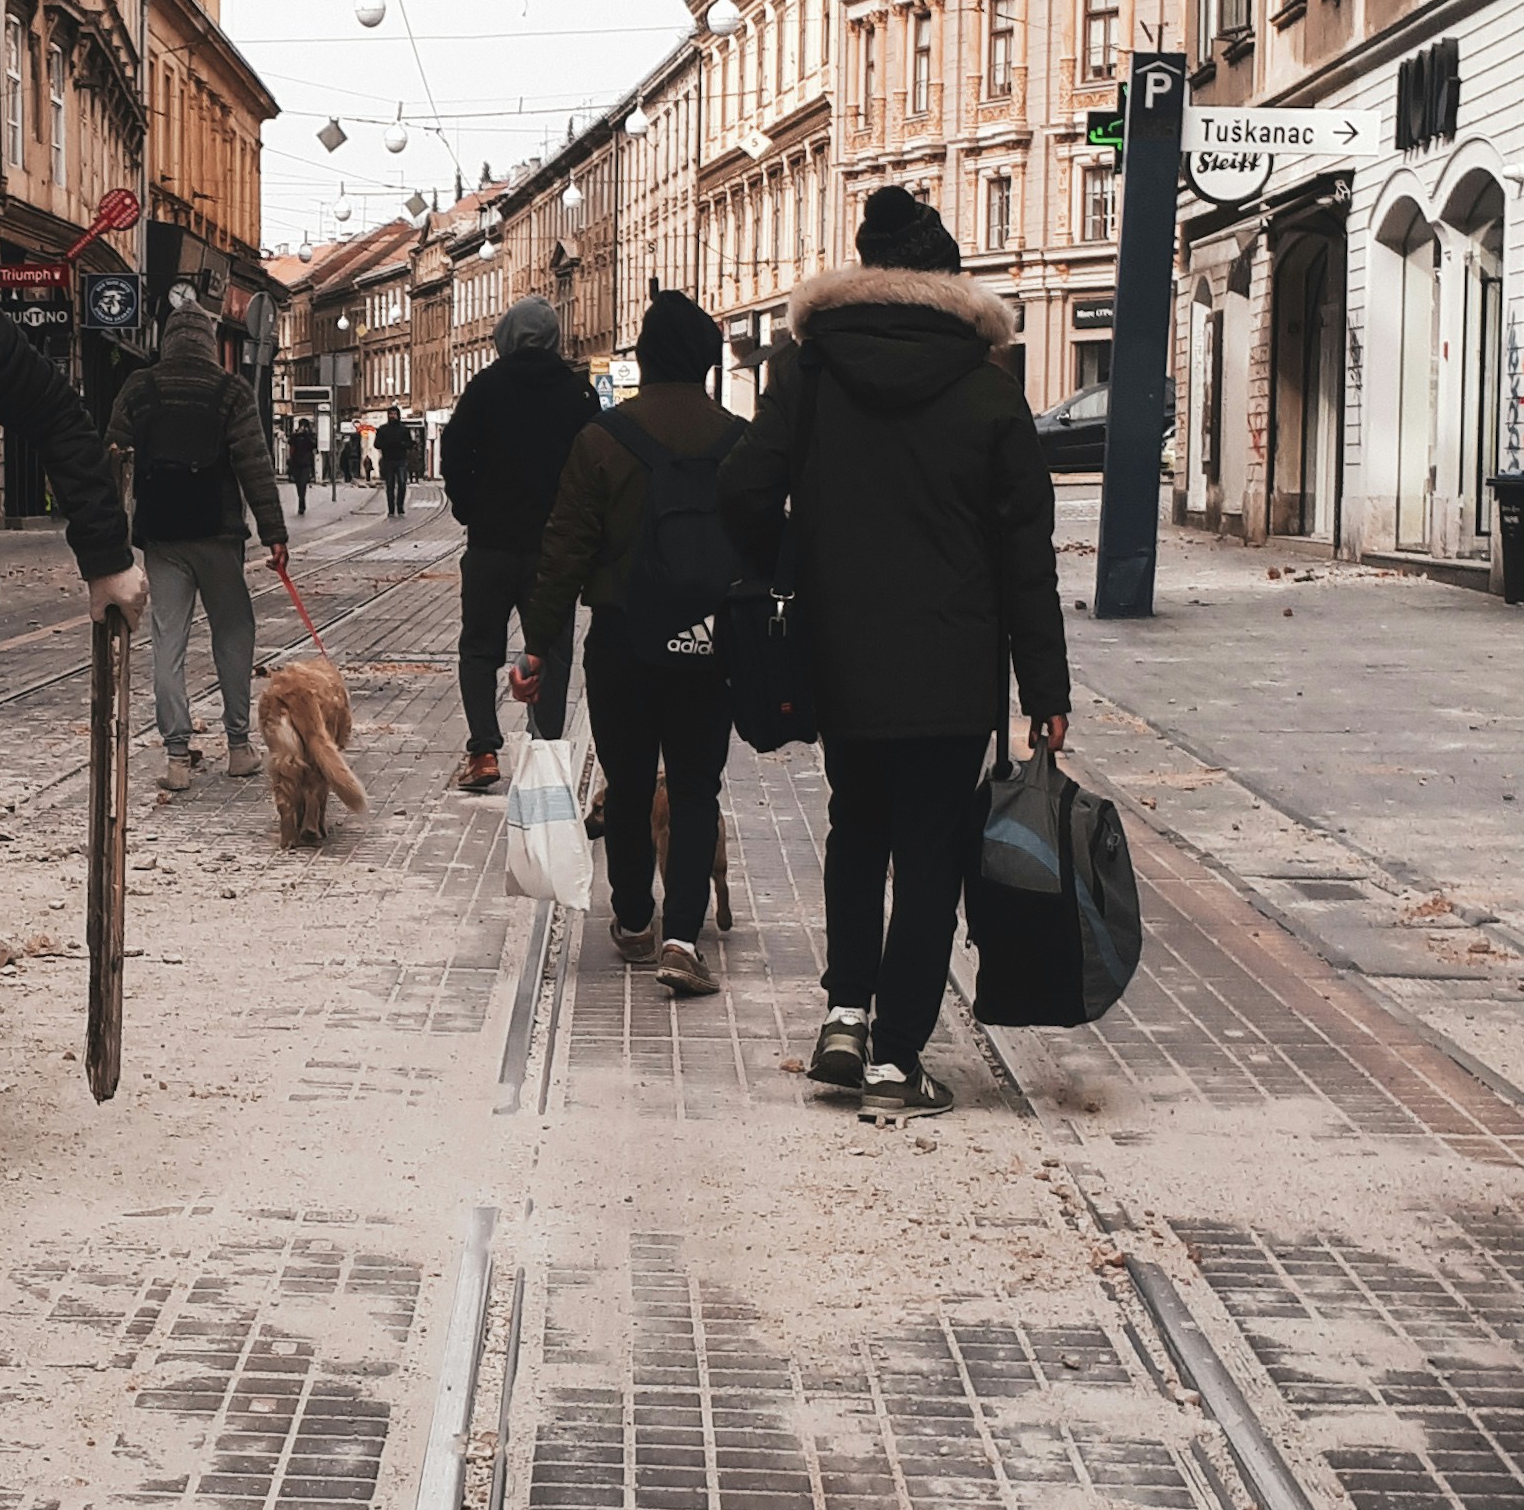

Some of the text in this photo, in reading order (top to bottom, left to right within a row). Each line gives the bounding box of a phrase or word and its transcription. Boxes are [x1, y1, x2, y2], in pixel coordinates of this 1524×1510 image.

[1144, 71, 1173, 110] P
[1200, 117, 1315, 145] Tuškanac
[0, 268, 51, 284] Triumph
[666, 639, 715, 656] adid
